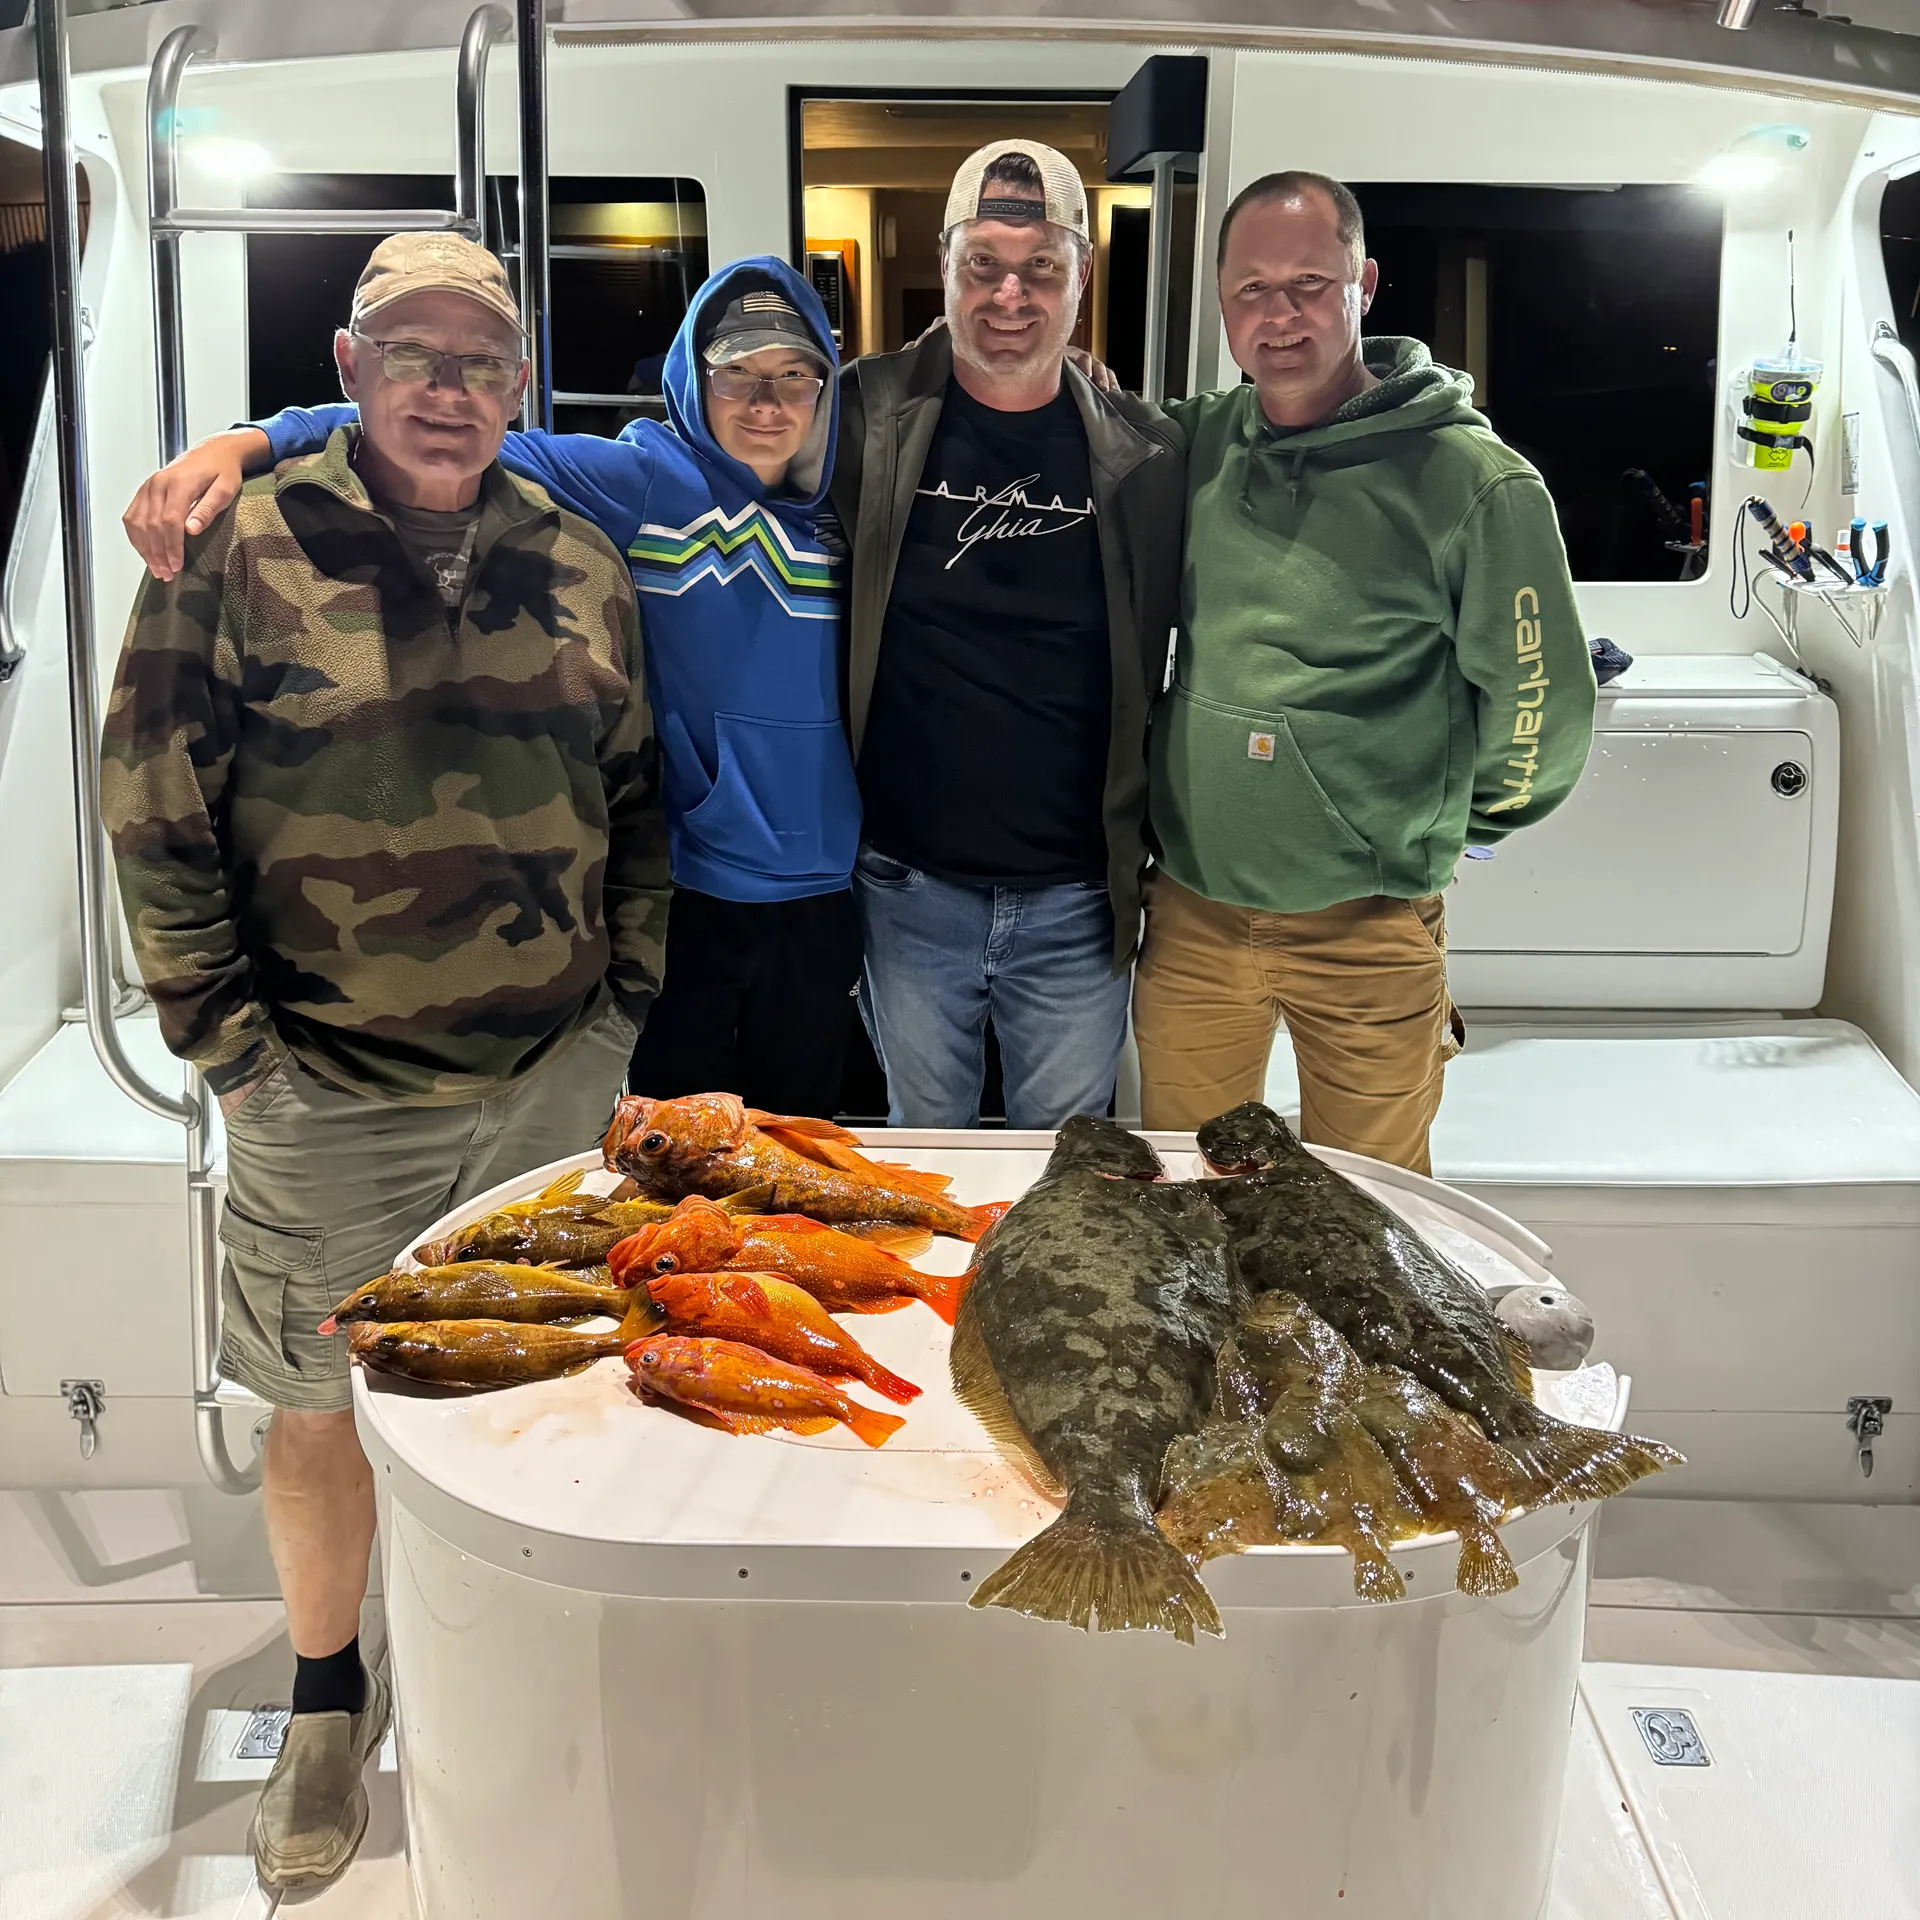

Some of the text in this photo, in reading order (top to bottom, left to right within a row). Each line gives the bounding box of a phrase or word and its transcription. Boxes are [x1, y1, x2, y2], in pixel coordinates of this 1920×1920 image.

[935, 480, 1096, 515] ARMAN
[944, 473, 1085, 569] Ghia
[1502, 586, 1550, 794] carhartt
